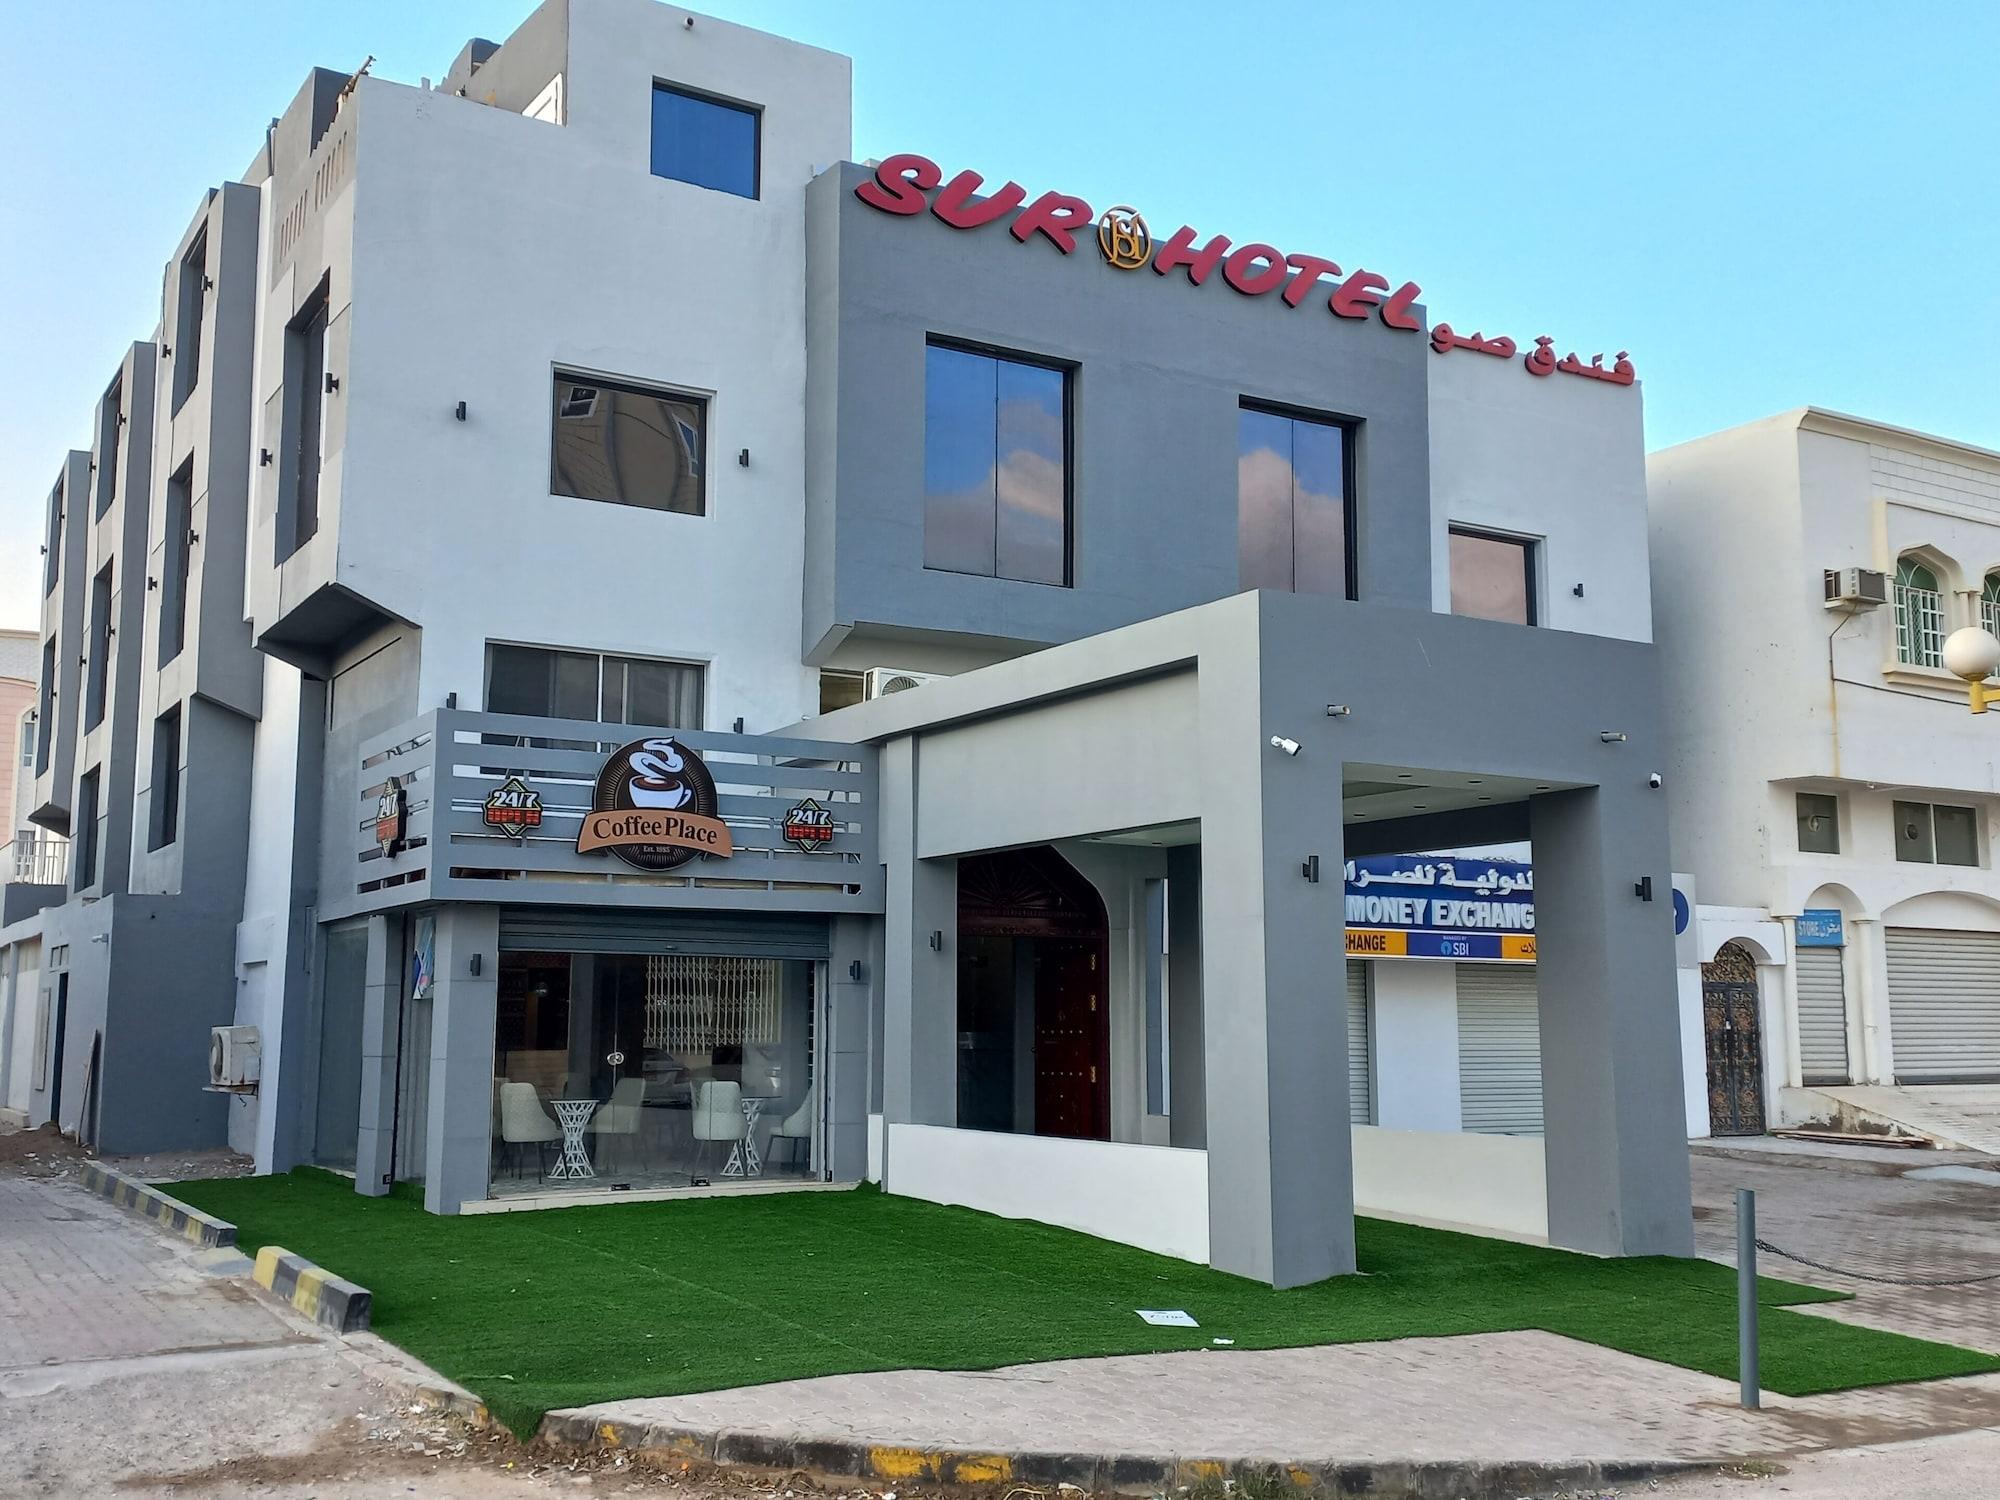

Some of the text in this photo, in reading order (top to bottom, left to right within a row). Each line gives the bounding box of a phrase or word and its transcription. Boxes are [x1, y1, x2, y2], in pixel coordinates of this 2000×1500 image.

[854, 154, 1093, 255] SUR
[1152, 224, 1422, 331] HOTEL
[1525, 335, 1636, 386] فندق
[494, 791, 538, 807] 24/7
[791, 809, 829, 825] 24/7
[593, 815, 718, 845] Coffee Place
[1344, 894, 1536, 930] MONEY EXCHANG
[1345, 933, 1386, 951] HANGE
[1453, 942, 1469, 955] SBI
